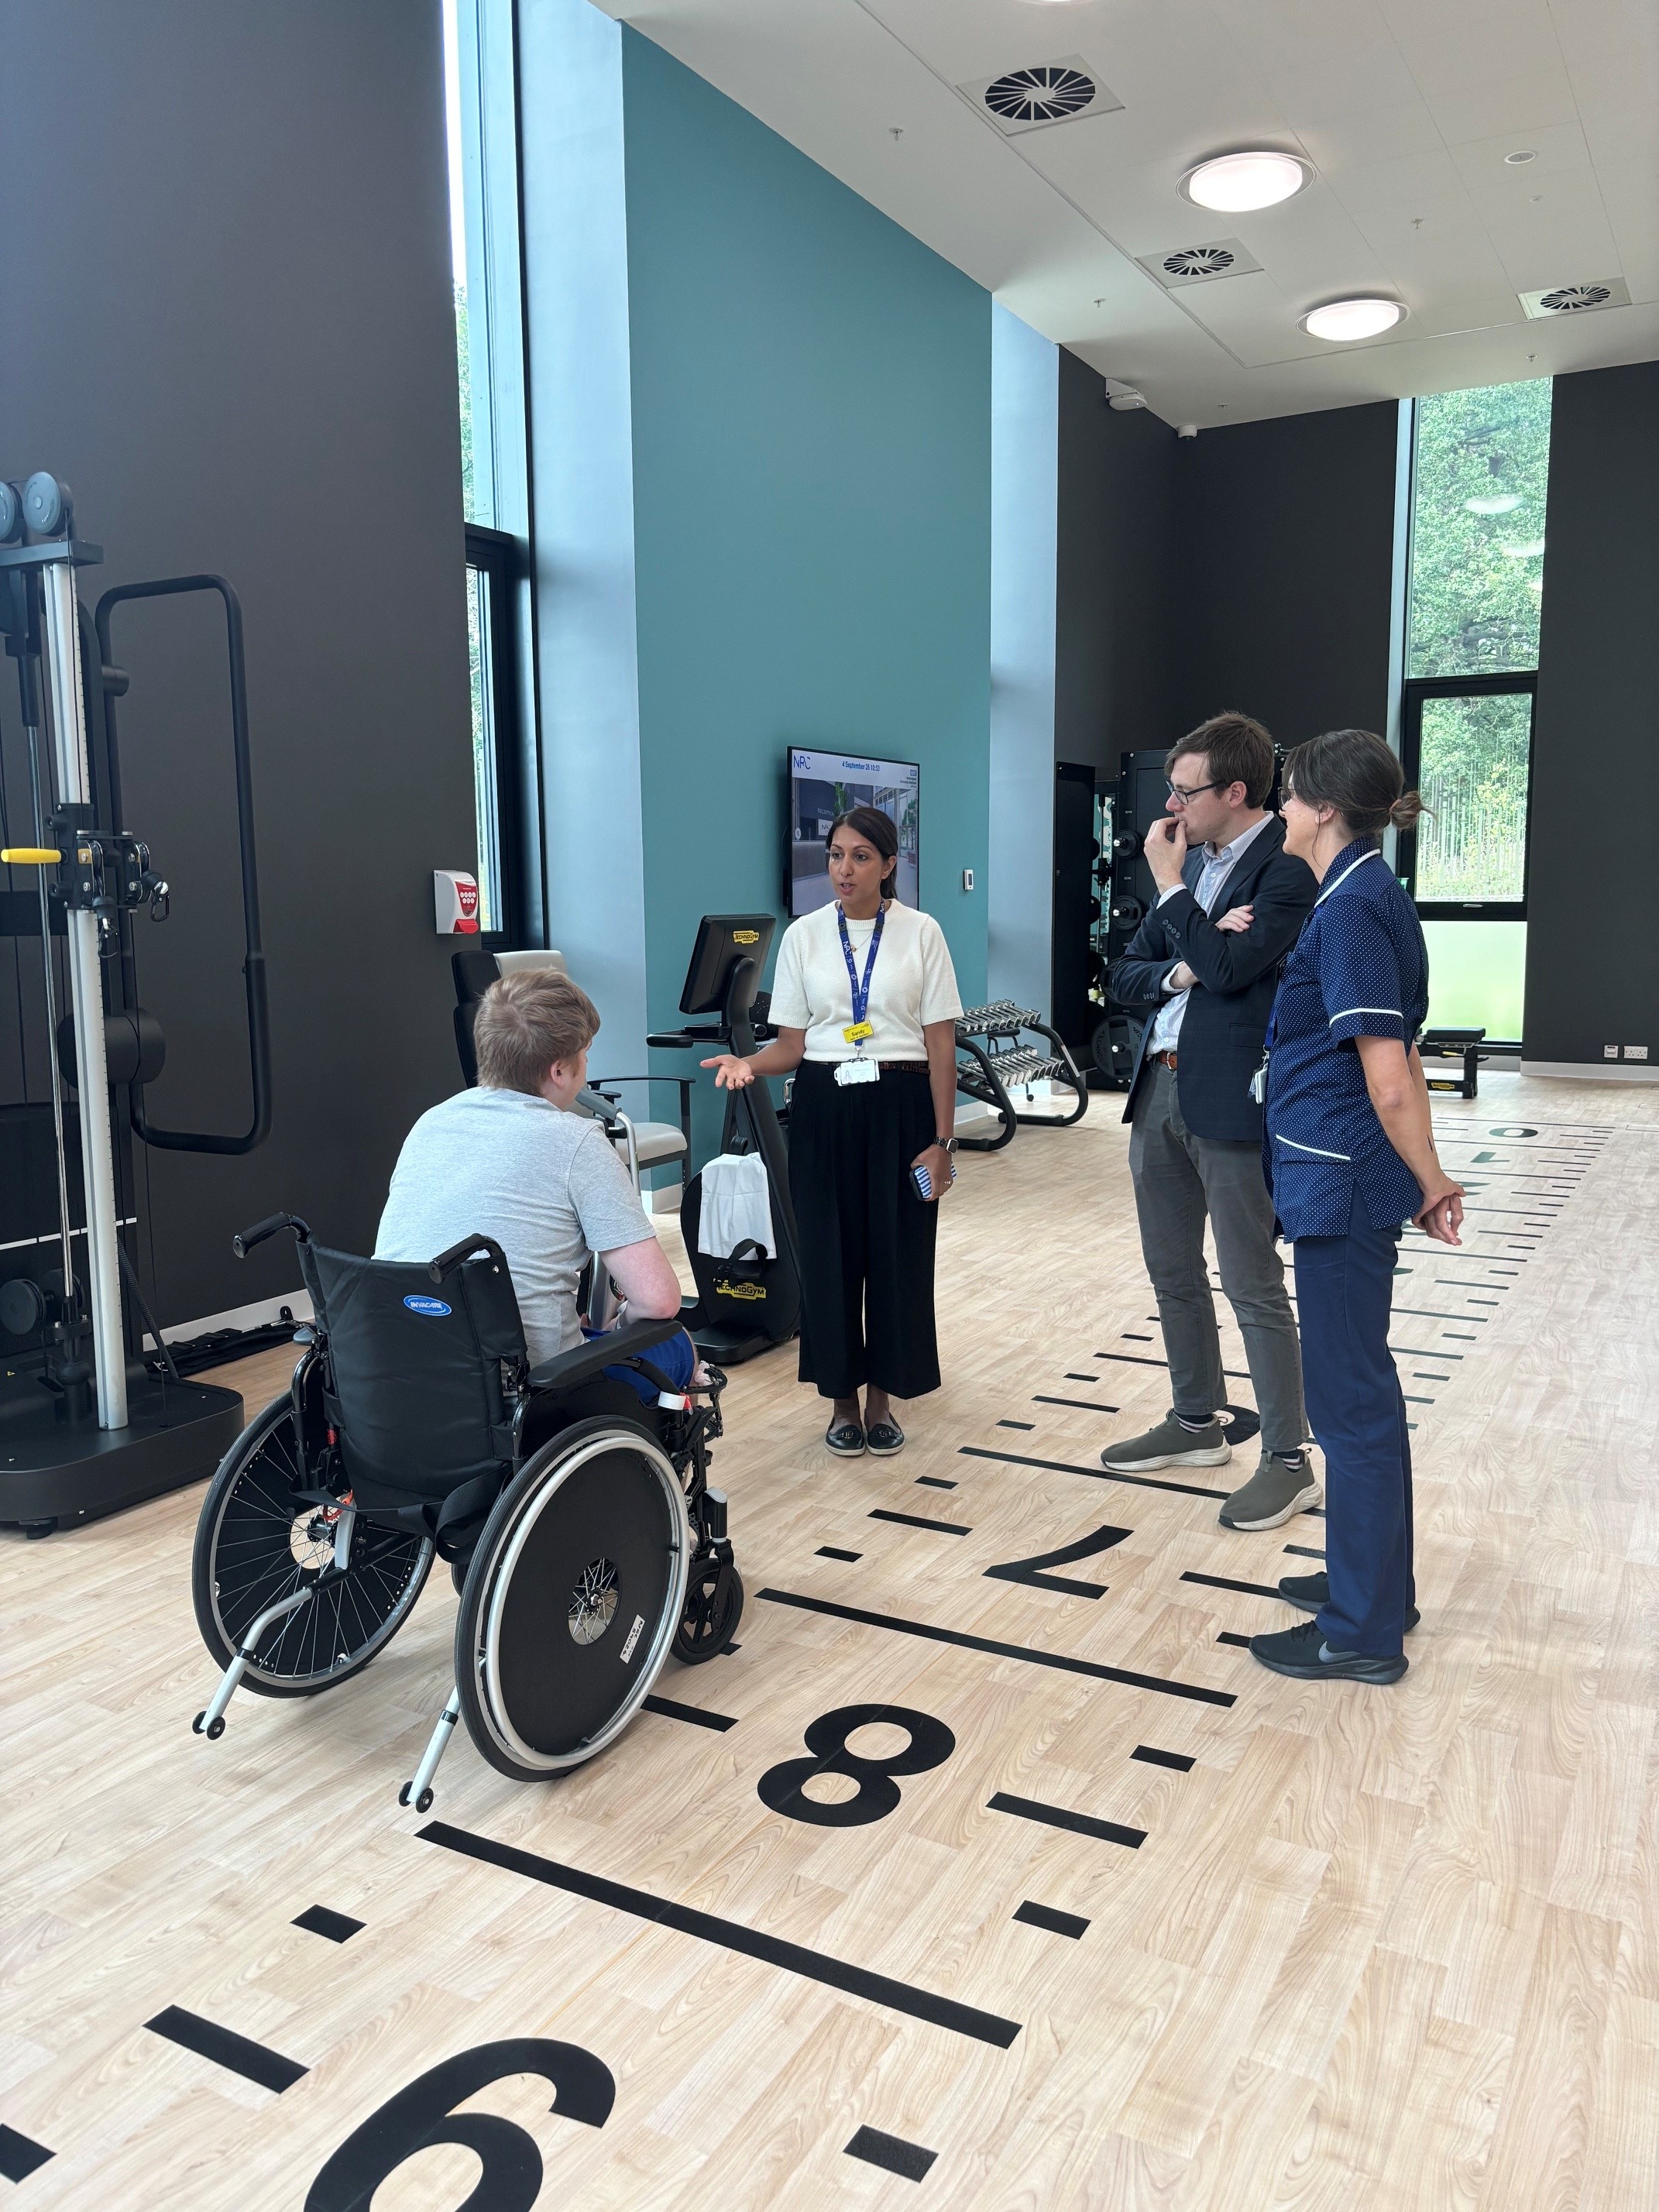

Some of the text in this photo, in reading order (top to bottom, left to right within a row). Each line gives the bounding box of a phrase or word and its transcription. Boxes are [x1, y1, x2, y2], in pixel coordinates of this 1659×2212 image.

[794, 754, 811, 770] NRC
[845, 761, 865, 770] September
[410, 1301, 443, 1310] INVACARE
[981, 1524, 1135, 1600] 7
[757, 1703, 955, 1827] 8
